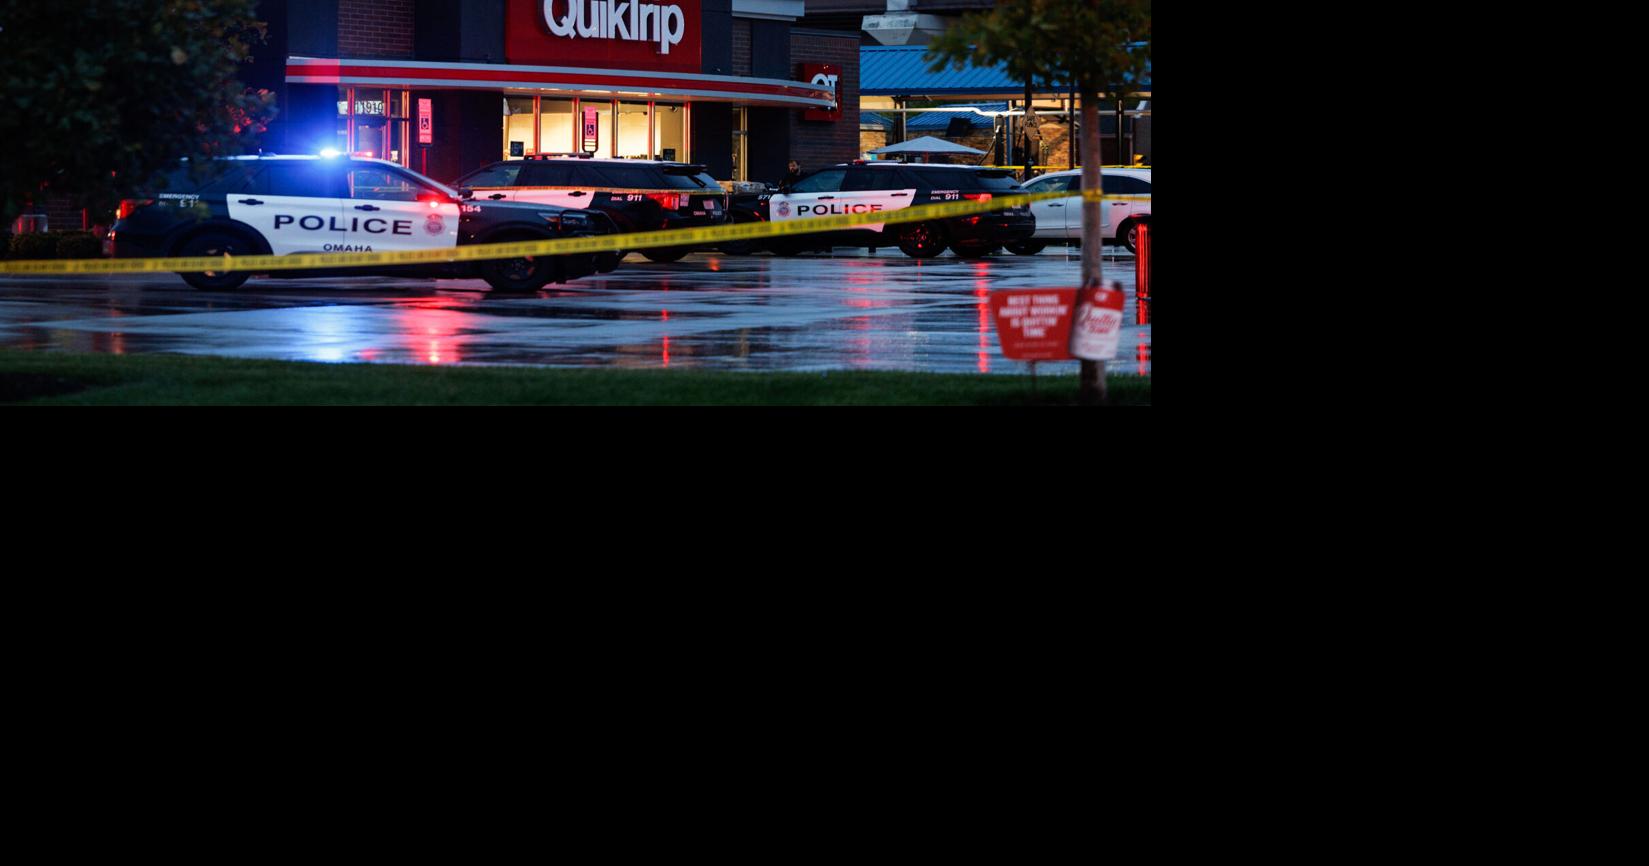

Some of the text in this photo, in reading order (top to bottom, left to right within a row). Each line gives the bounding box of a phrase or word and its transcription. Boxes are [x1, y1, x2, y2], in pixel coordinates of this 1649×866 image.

[543, 0, 685, 54] QuikTrip
[797, 204, 883, 216] POLICE
[274, 214, 413, 235] POLICE
[323, 243, 373, 253] OMAHA
